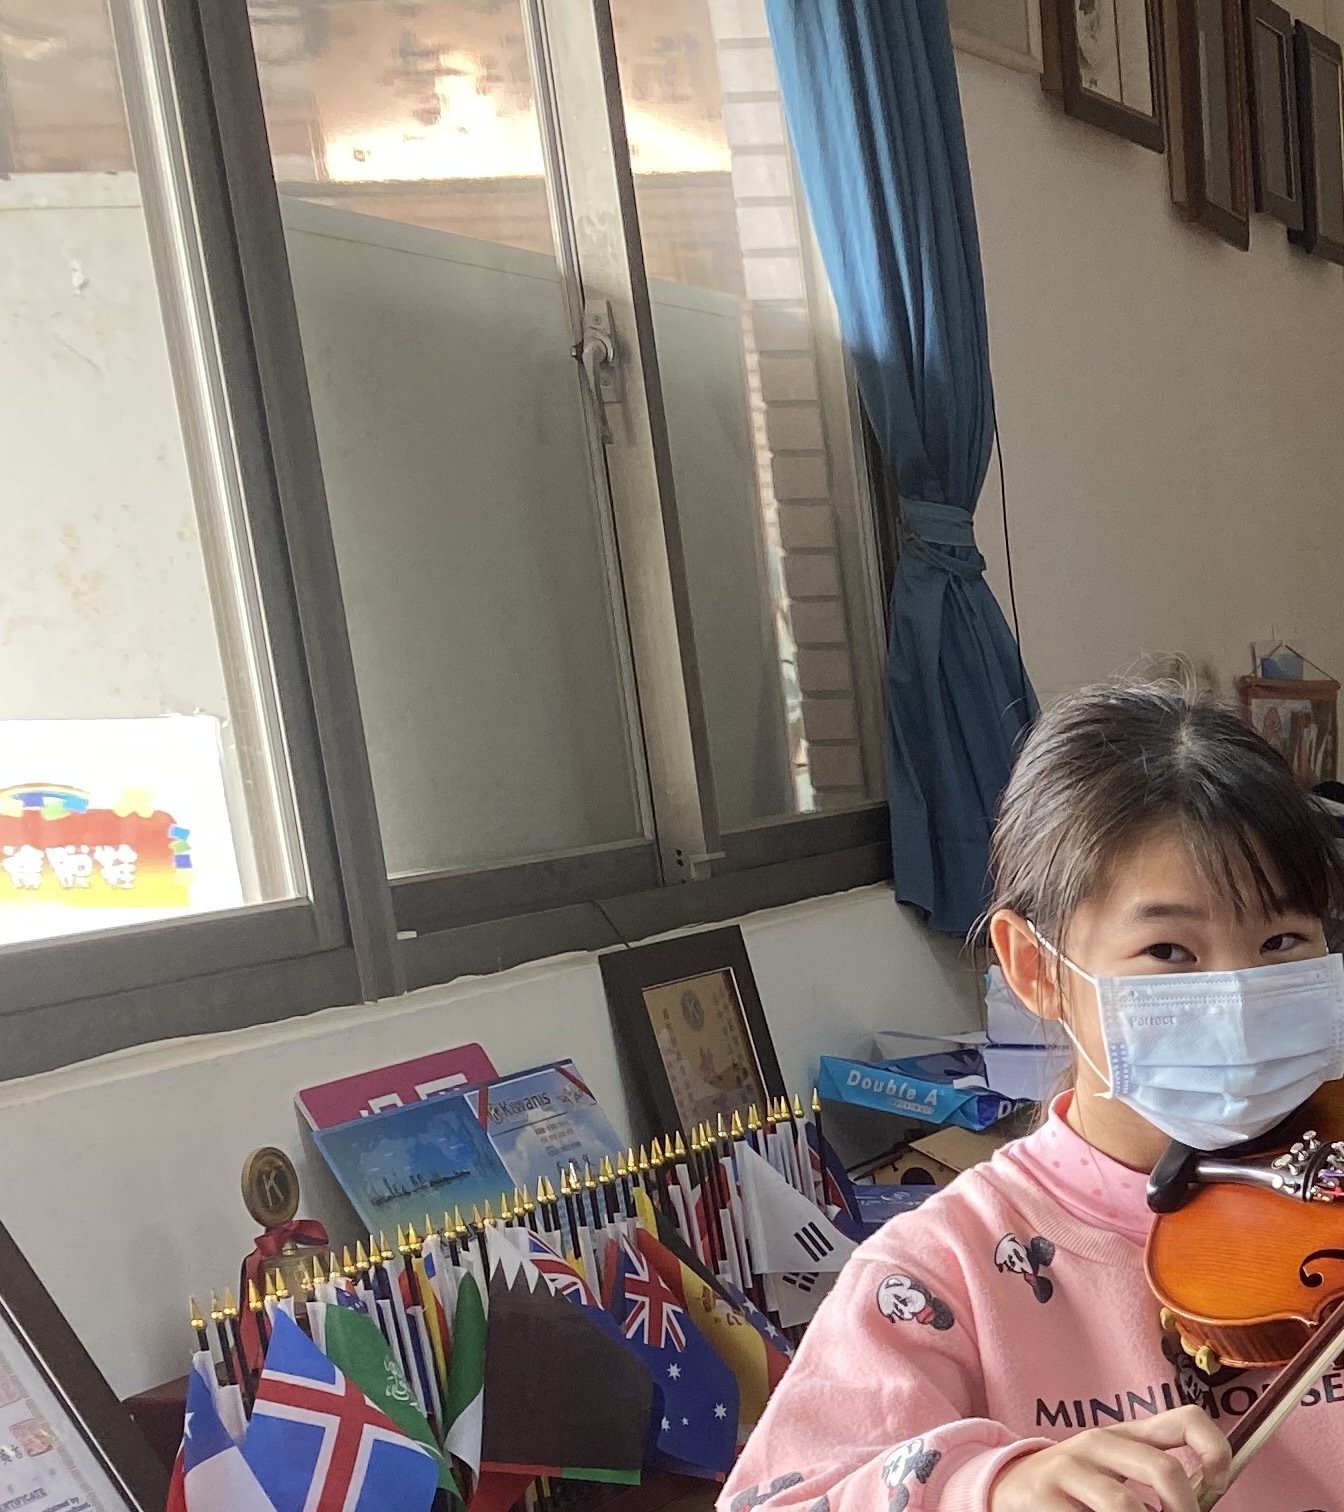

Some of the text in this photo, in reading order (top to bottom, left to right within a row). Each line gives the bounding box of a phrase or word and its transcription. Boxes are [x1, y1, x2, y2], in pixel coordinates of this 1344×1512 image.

[846, 1069, 938, 1106] Double A
[500, 1091, 551, 1115] Kiwanis
